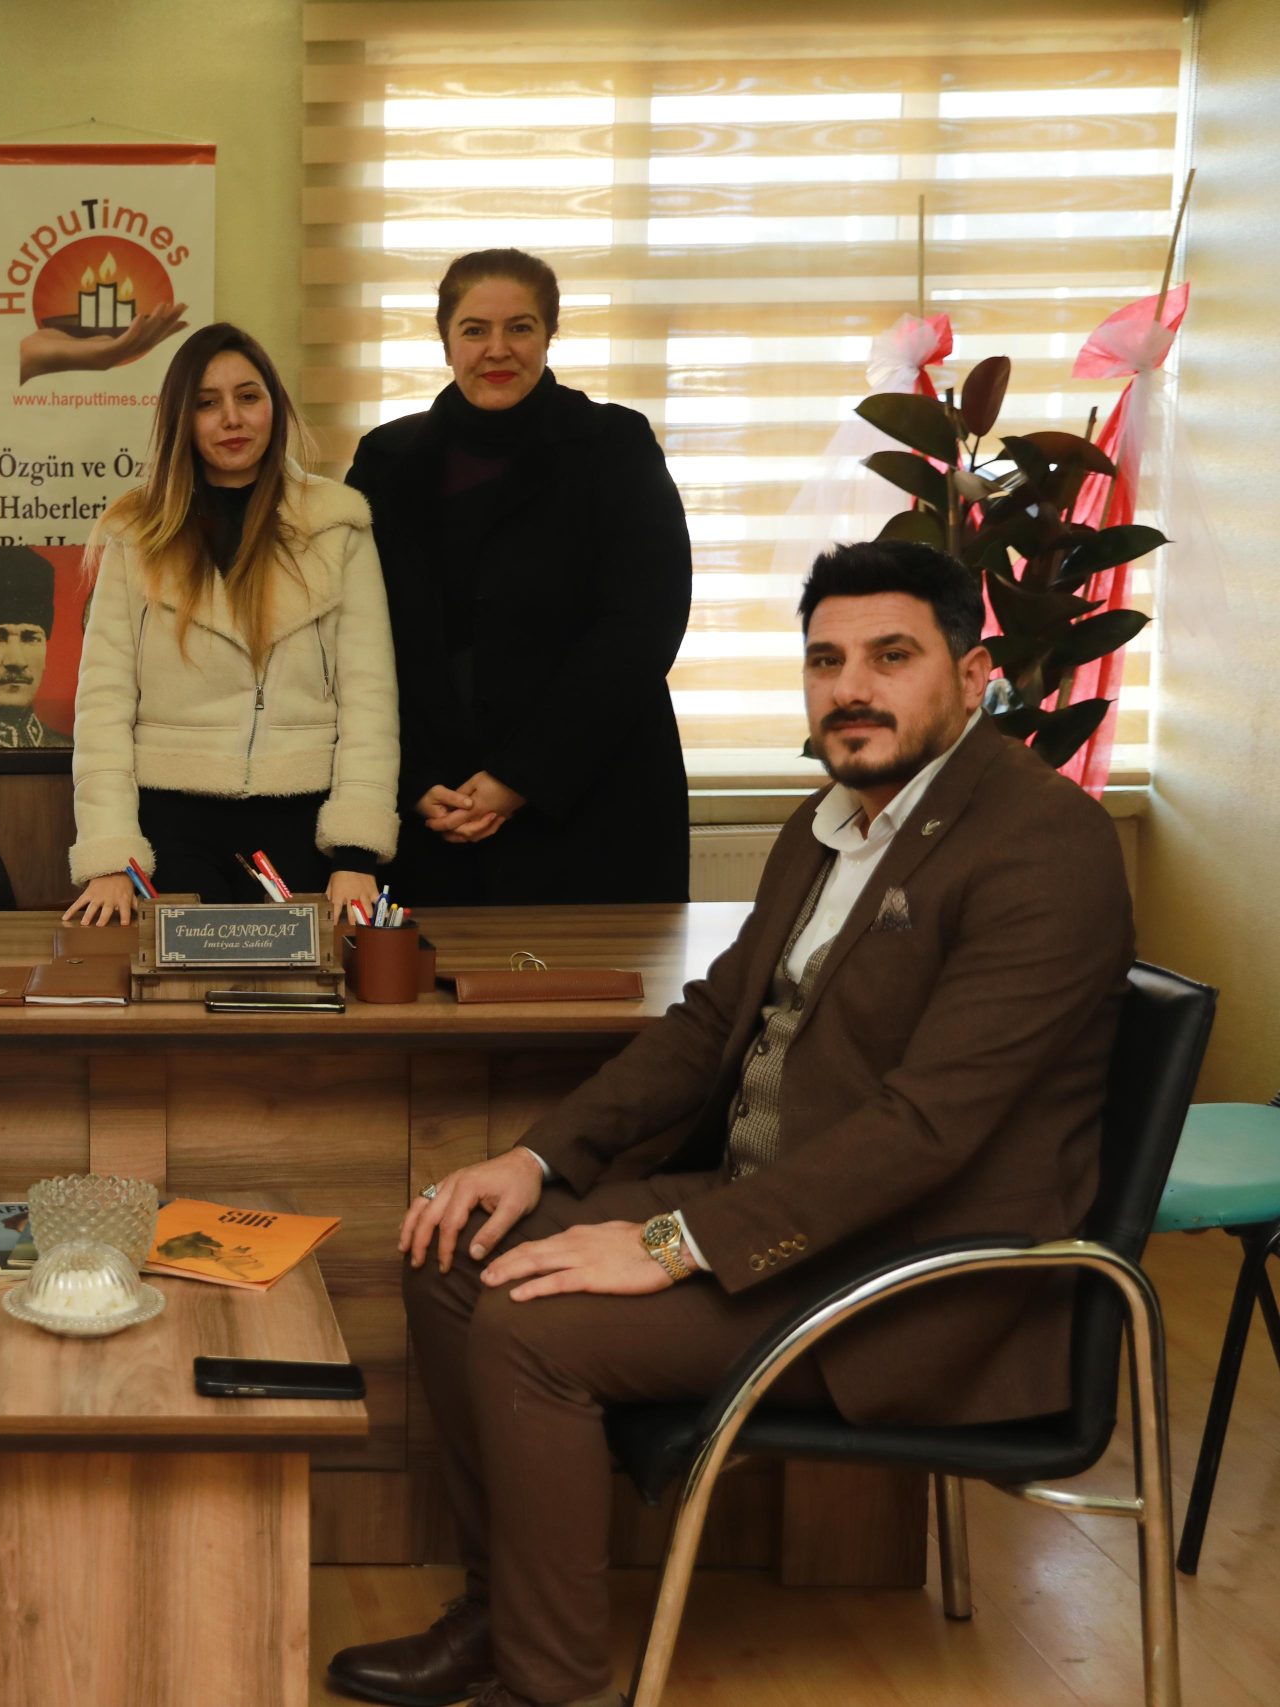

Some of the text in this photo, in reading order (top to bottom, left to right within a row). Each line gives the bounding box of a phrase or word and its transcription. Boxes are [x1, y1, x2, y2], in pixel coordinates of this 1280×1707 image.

[13, 392, 161, 409] www.harputtimes.co
[81, 461, 106, 478] ve
[114, 448, 147, 478] Öz
[175, 922, 299, 938] Funda CANPOLAT
